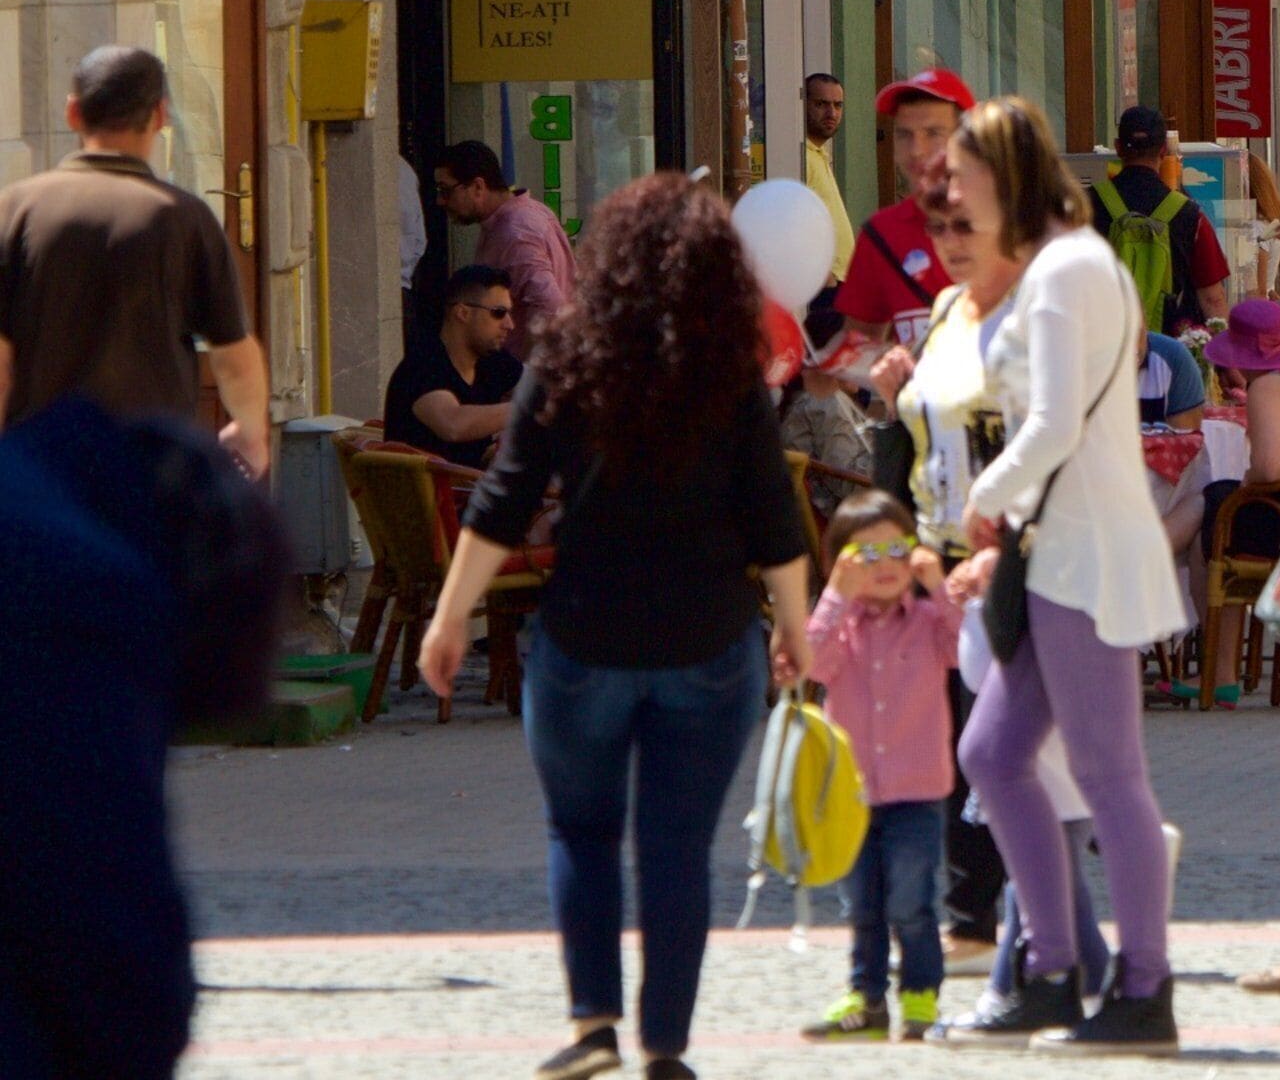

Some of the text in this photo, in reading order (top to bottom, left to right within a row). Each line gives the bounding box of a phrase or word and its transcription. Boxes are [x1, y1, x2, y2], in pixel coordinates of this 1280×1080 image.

[488, 1, 572, 25] NE-AȚI
[488, 30, 554, 50] ALES!
[1215, 8, 1263, 131] JABRI
